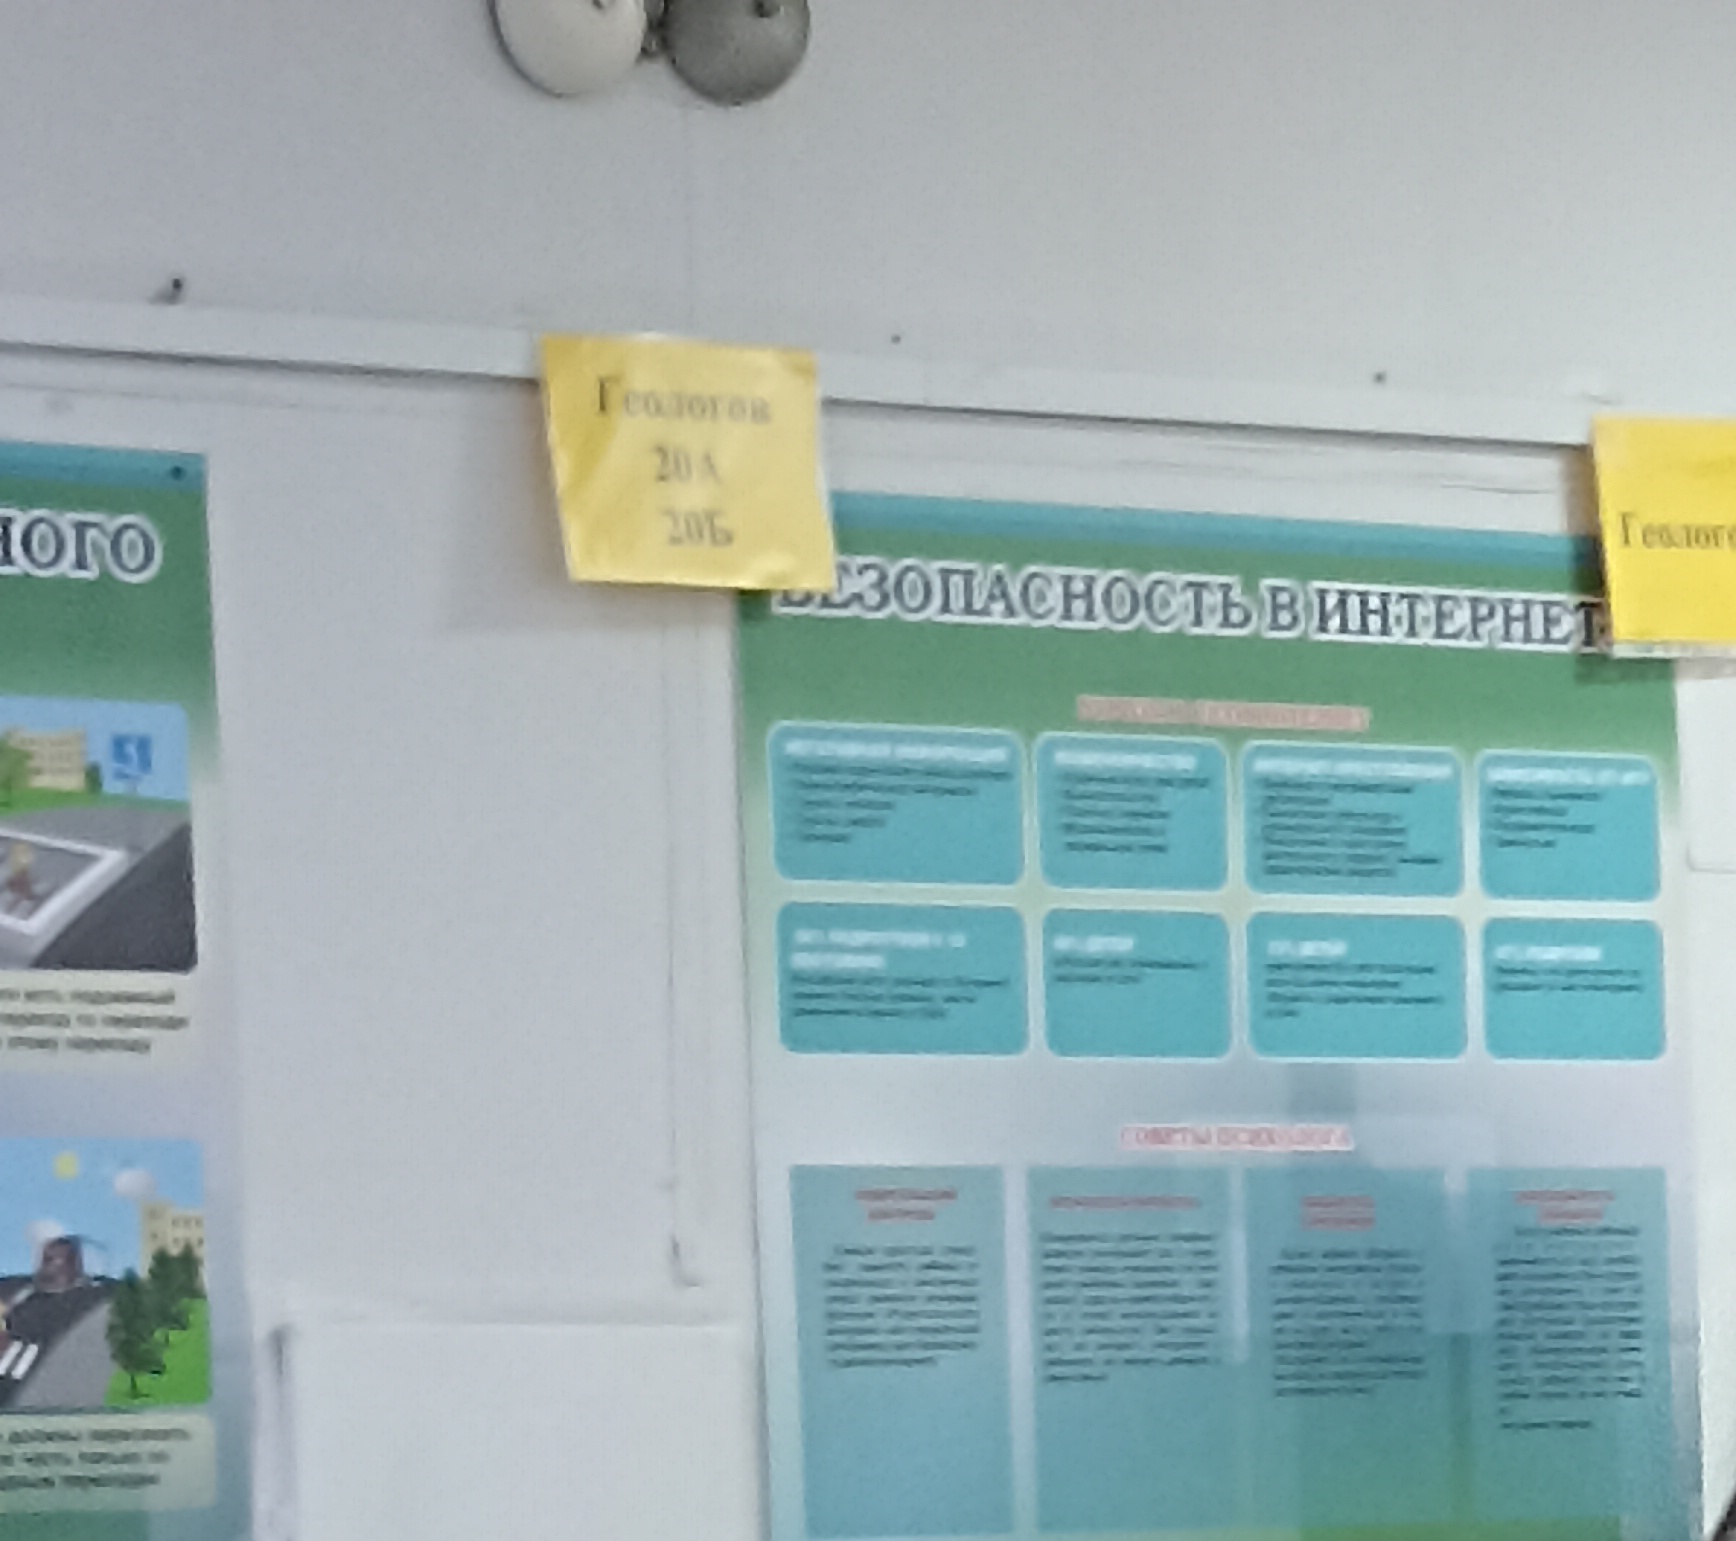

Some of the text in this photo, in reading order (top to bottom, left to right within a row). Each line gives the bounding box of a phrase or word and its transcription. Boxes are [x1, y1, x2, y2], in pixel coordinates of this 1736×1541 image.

[597, 373, 772, 425] Геологов
[661, 508, 735, 548] 20Б
[777, 561, 1609, 649] ЕЗОПАСНОСТЬ В ИНТЕРНЕТ
